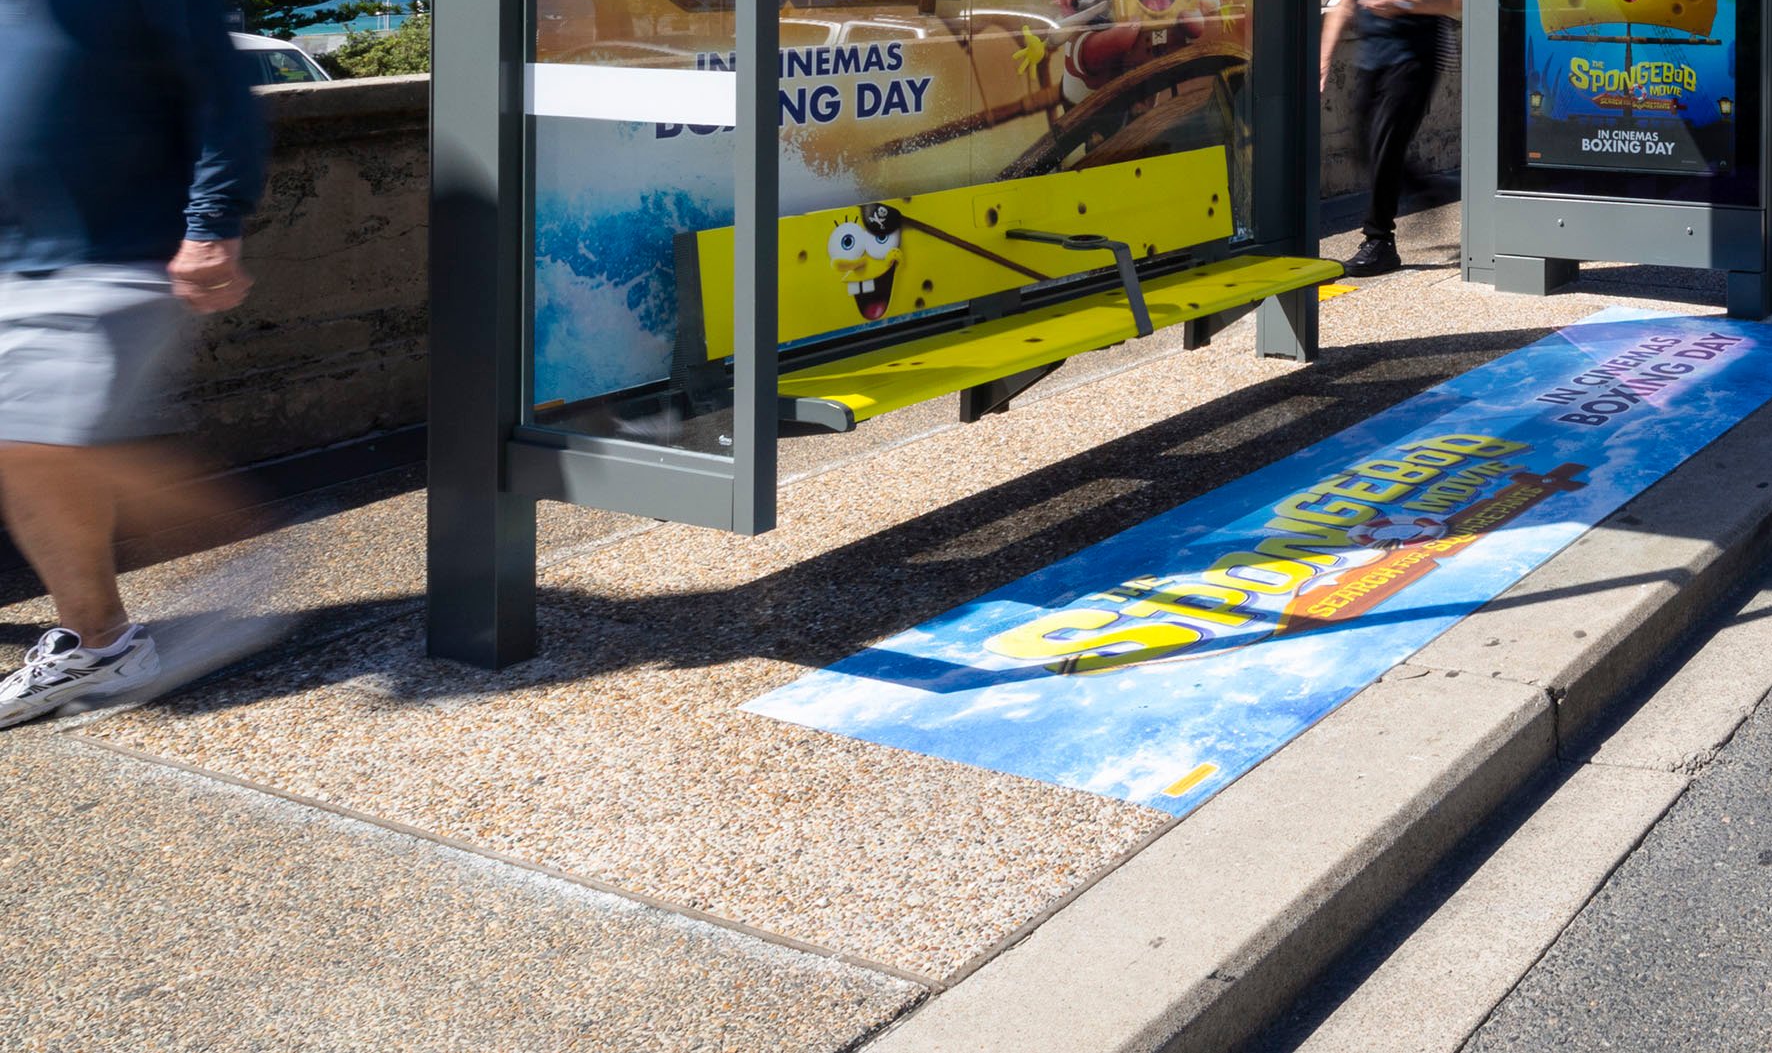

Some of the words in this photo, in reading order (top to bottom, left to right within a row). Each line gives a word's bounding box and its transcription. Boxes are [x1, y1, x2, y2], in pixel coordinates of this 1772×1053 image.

[779, 42, 904, 79] INEMAS
[1570, 57, 1697, 92] SPONGEBOB
[1592, 60, 1605, 69] THE
[855, 76, 932, 119] DAY
[1649, 84, 1683, 97] MOVIE
[1581, 138, 1641, 154] BOXING
[1645, 141, 1676, 156] DAY
[1597, 129, 1610, 140] IN
[1612, 130, 1659, 142] CINEMAS
[1536, 387, 1588, 405] IN
[1573, 336, 1682, 386] CINEMAS
[1557, 362, 1695, 427] BOXING
[1673, 332, 1744, 360] DAY
[1402, 461, 1526, 513] MOVIE
[982, 433, 1532, 676] SPONGEBOB
[1306, 567, 1405, 618] SEARCH
[1391, 550, 1430, 571] FOR
[1423, 484, 1543, 553] SQUAREPANTS
